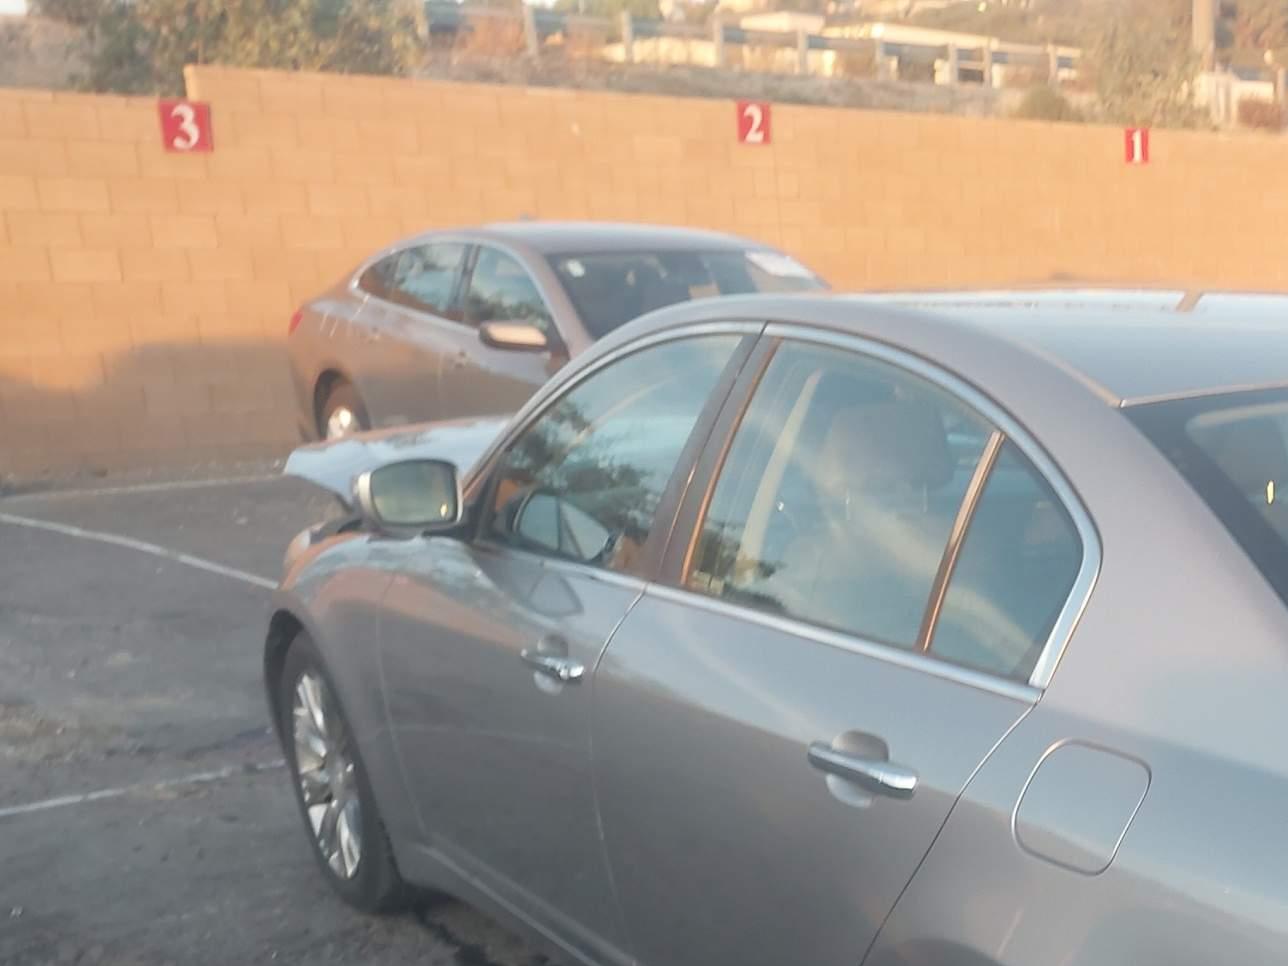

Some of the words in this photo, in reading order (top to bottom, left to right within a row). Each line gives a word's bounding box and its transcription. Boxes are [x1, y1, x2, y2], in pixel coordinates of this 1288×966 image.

[170, 104, 199, 149] 3
[743, 104, 764, 143] 2
[1131, 130, 1143, 163] 1
